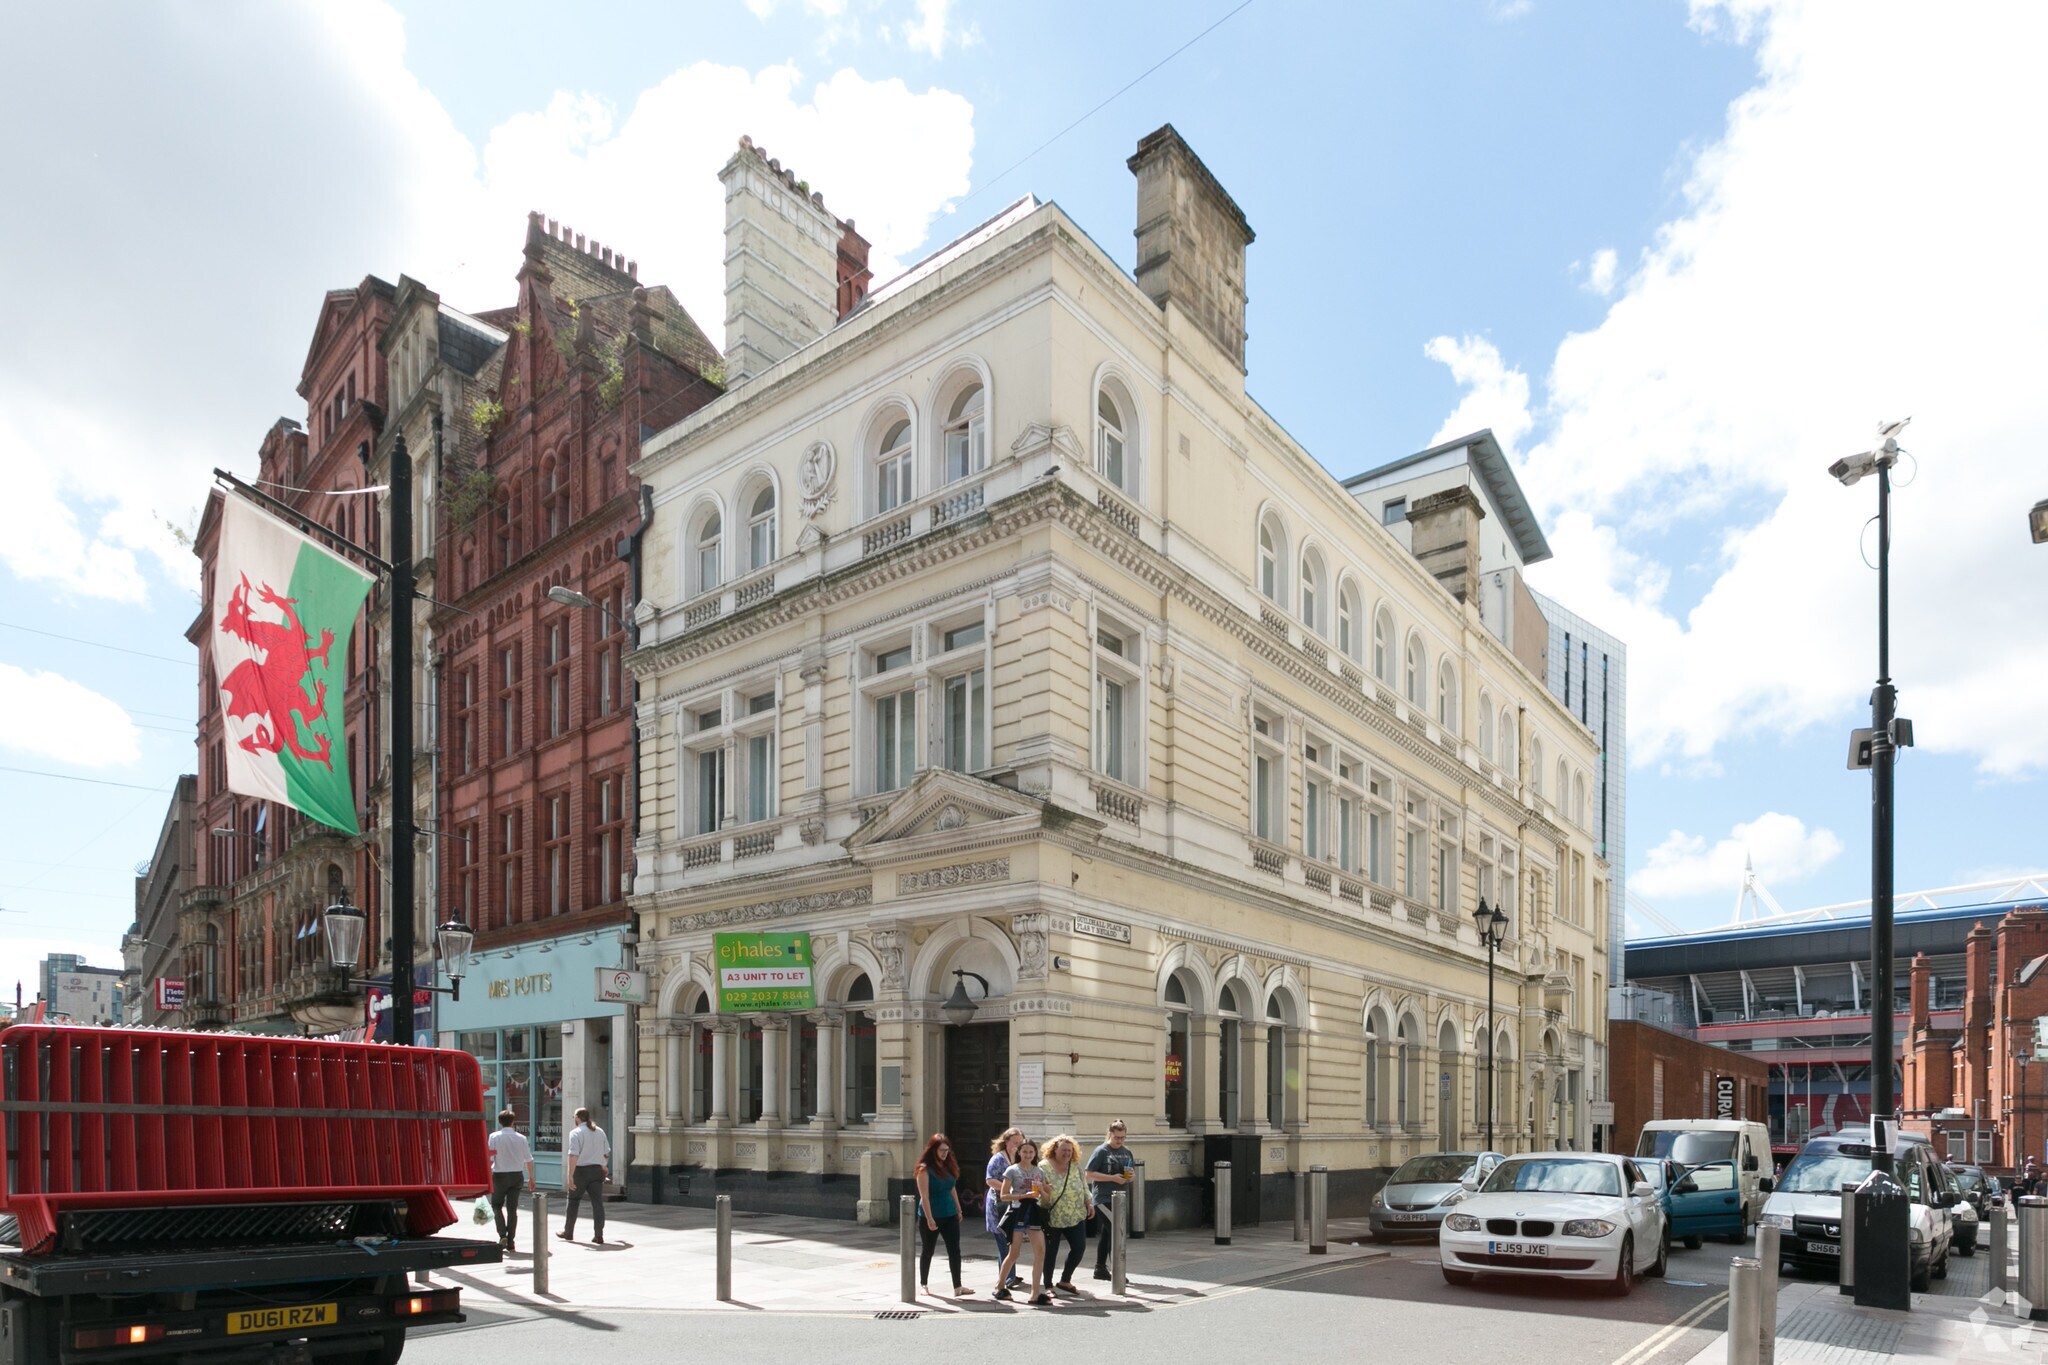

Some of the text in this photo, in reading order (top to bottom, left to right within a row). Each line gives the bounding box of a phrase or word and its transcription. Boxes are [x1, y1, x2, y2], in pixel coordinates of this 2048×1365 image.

[1076, 915, 1122, 932] GUILDHALL PLACE
[1076, 923, 1090, 932] PLAS
[721, 940, 783, 963] ejhales
[727, 972, 805, 981] A3 UNIT TO LET
[488, 973, 553, 999] MRS POTTS
[604, 990, 621, 999] Papa
[726, 991, 810, 1002] 029 2037 8844
[733, 1000, 802, 1008] www.ejhales.co.uk
[1496, 1243, 1546, 1255] EJ59 JXE
[1810, 1243, 1835, 1253] SH56
[240, 1307, 325, 1330] DU61 RZW
